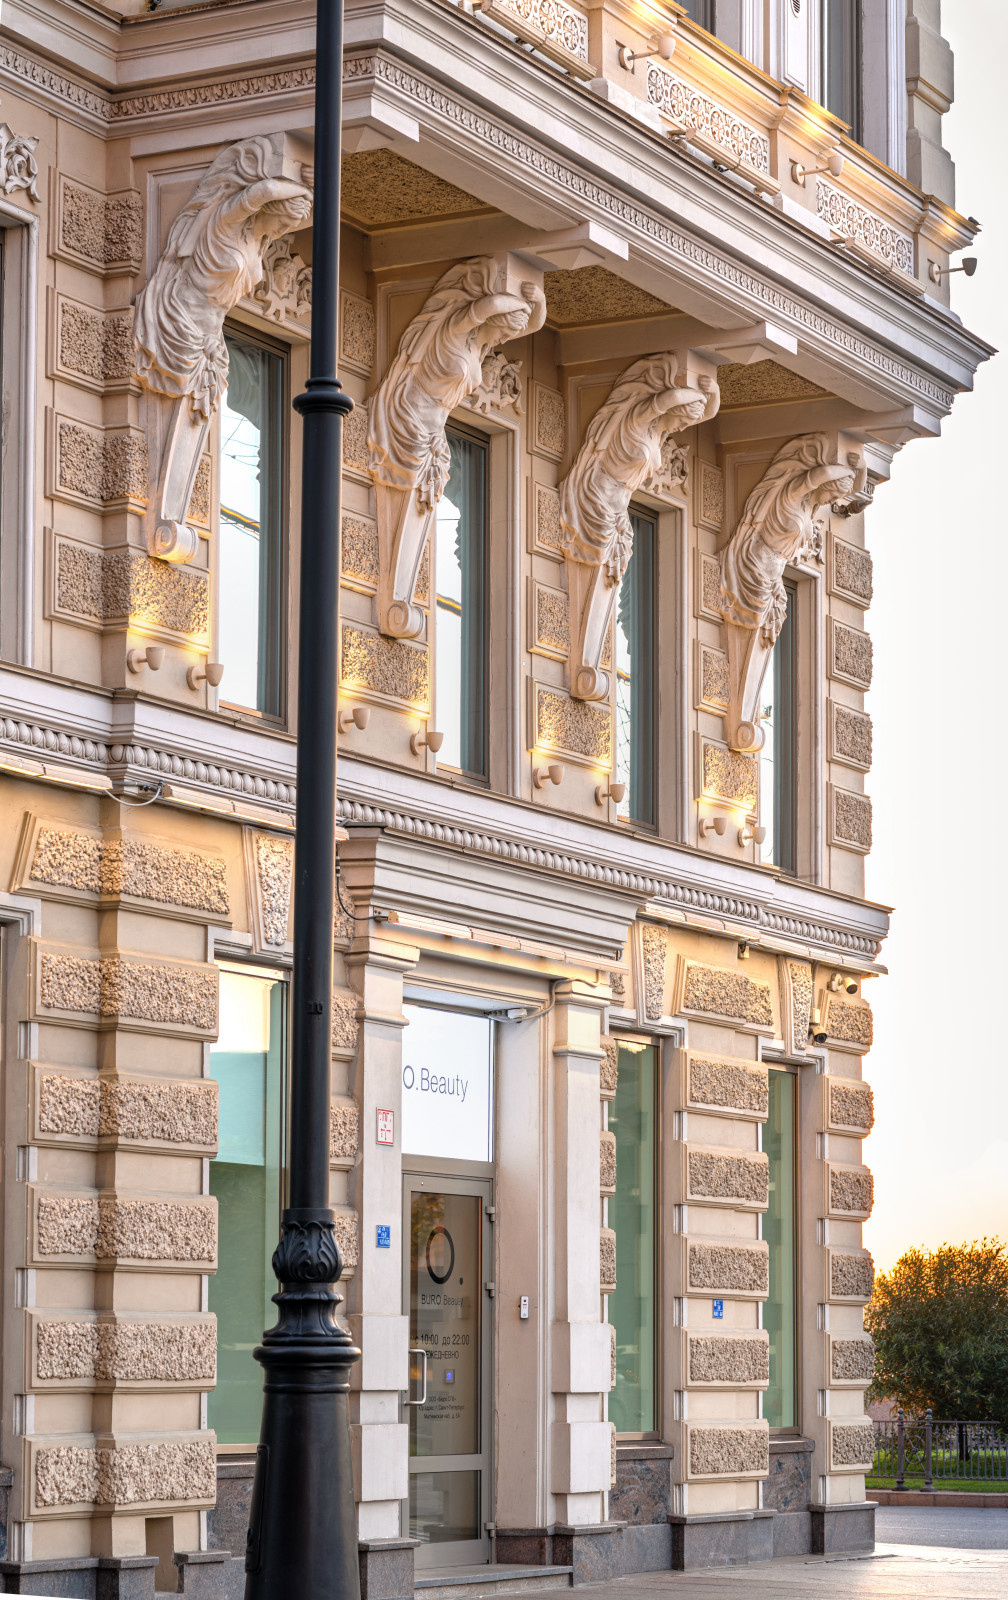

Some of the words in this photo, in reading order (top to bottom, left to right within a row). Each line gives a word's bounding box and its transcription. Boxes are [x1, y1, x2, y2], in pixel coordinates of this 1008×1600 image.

[403, 1065, 468, 1102] O.Beauty
[421, 1294, 442, 1305] BURO
[421, 1334, 439, 1345] 10:00
[442, 1336, 451, 1346] до
[452, 1334, 470, 1345] 22:00
